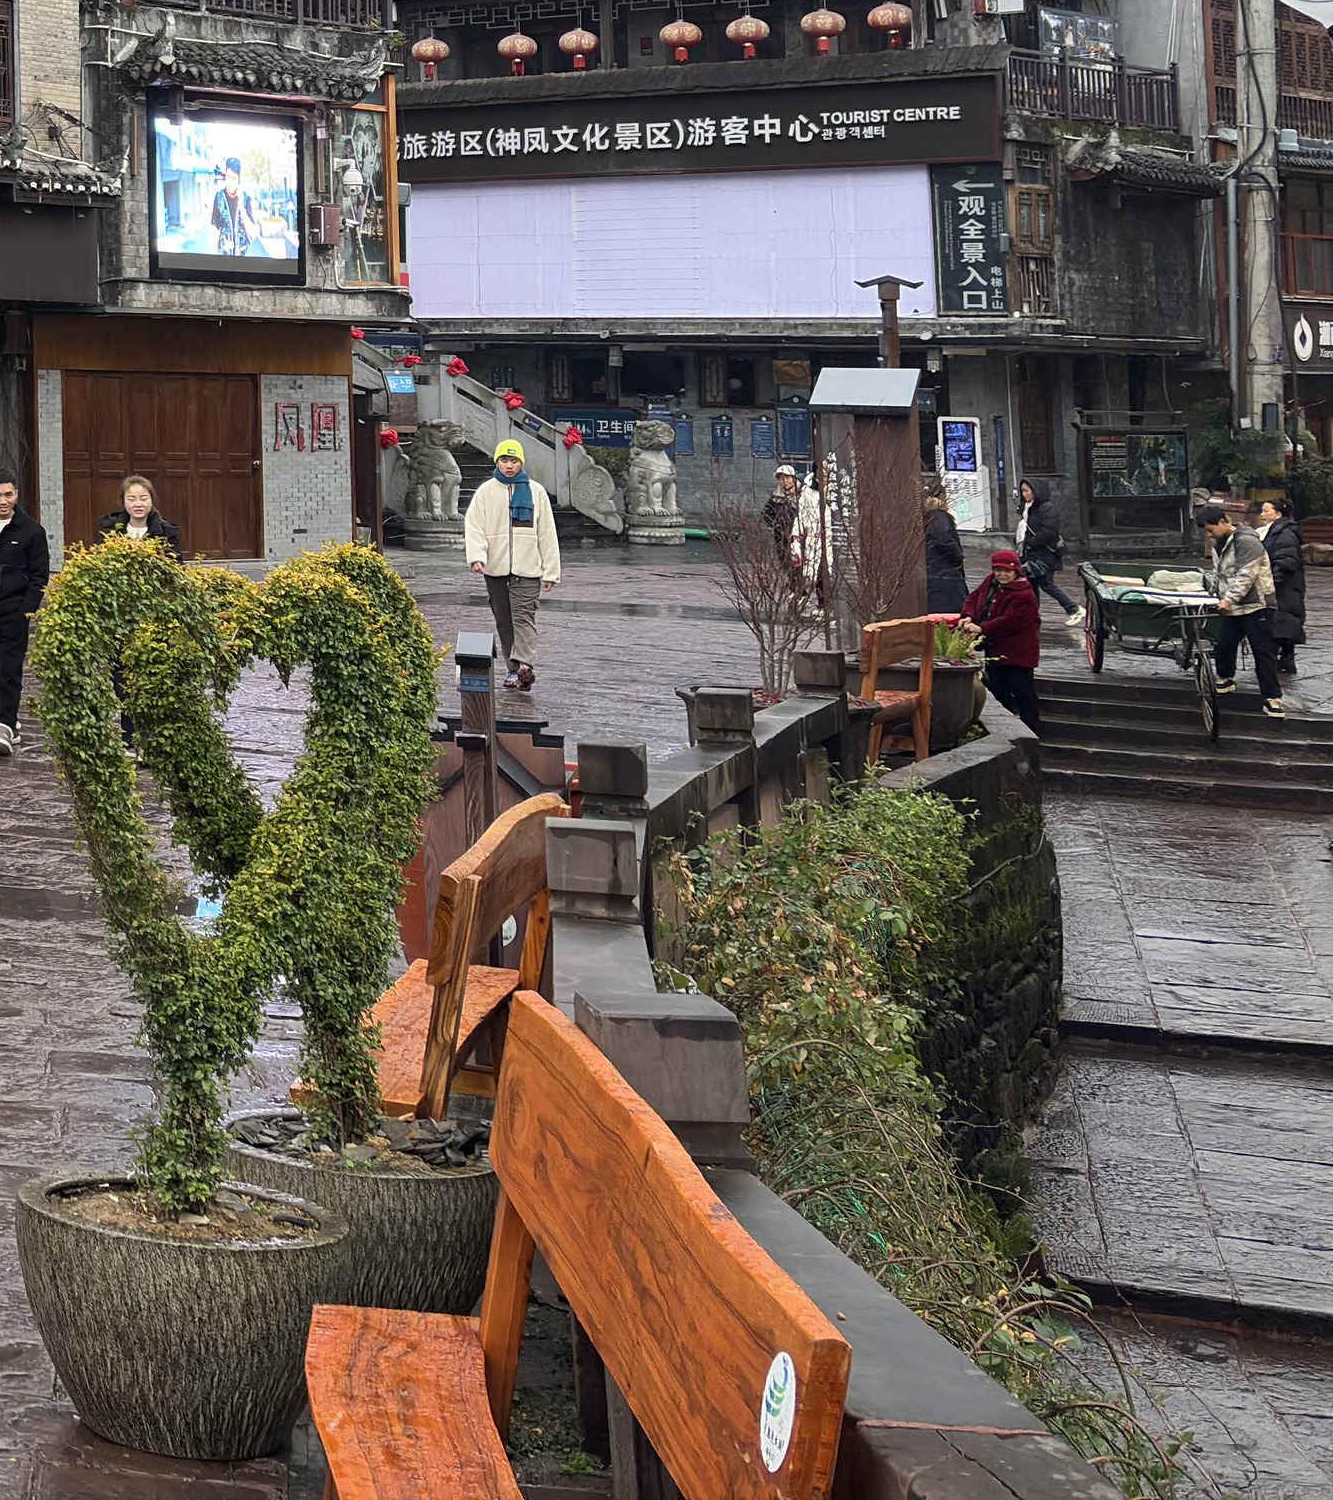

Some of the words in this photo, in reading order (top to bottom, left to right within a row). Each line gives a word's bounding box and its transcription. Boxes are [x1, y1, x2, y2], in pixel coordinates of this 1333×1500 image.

[396, 114, 820, 161] 旅游区(神凤文化景区)游客中心
[820, 109, 889, 125] TOURIST
[893, 106, 960, 122] CENTRE
[821, 125, 885, 140] 관광객센터
[958, 195, 988, 310] 观全景入口
[990, 265, 1004, 310] 电梯上山
[274, 402, 343, 452] 凤凰
[596, 419, 634, 434] 卫生间
